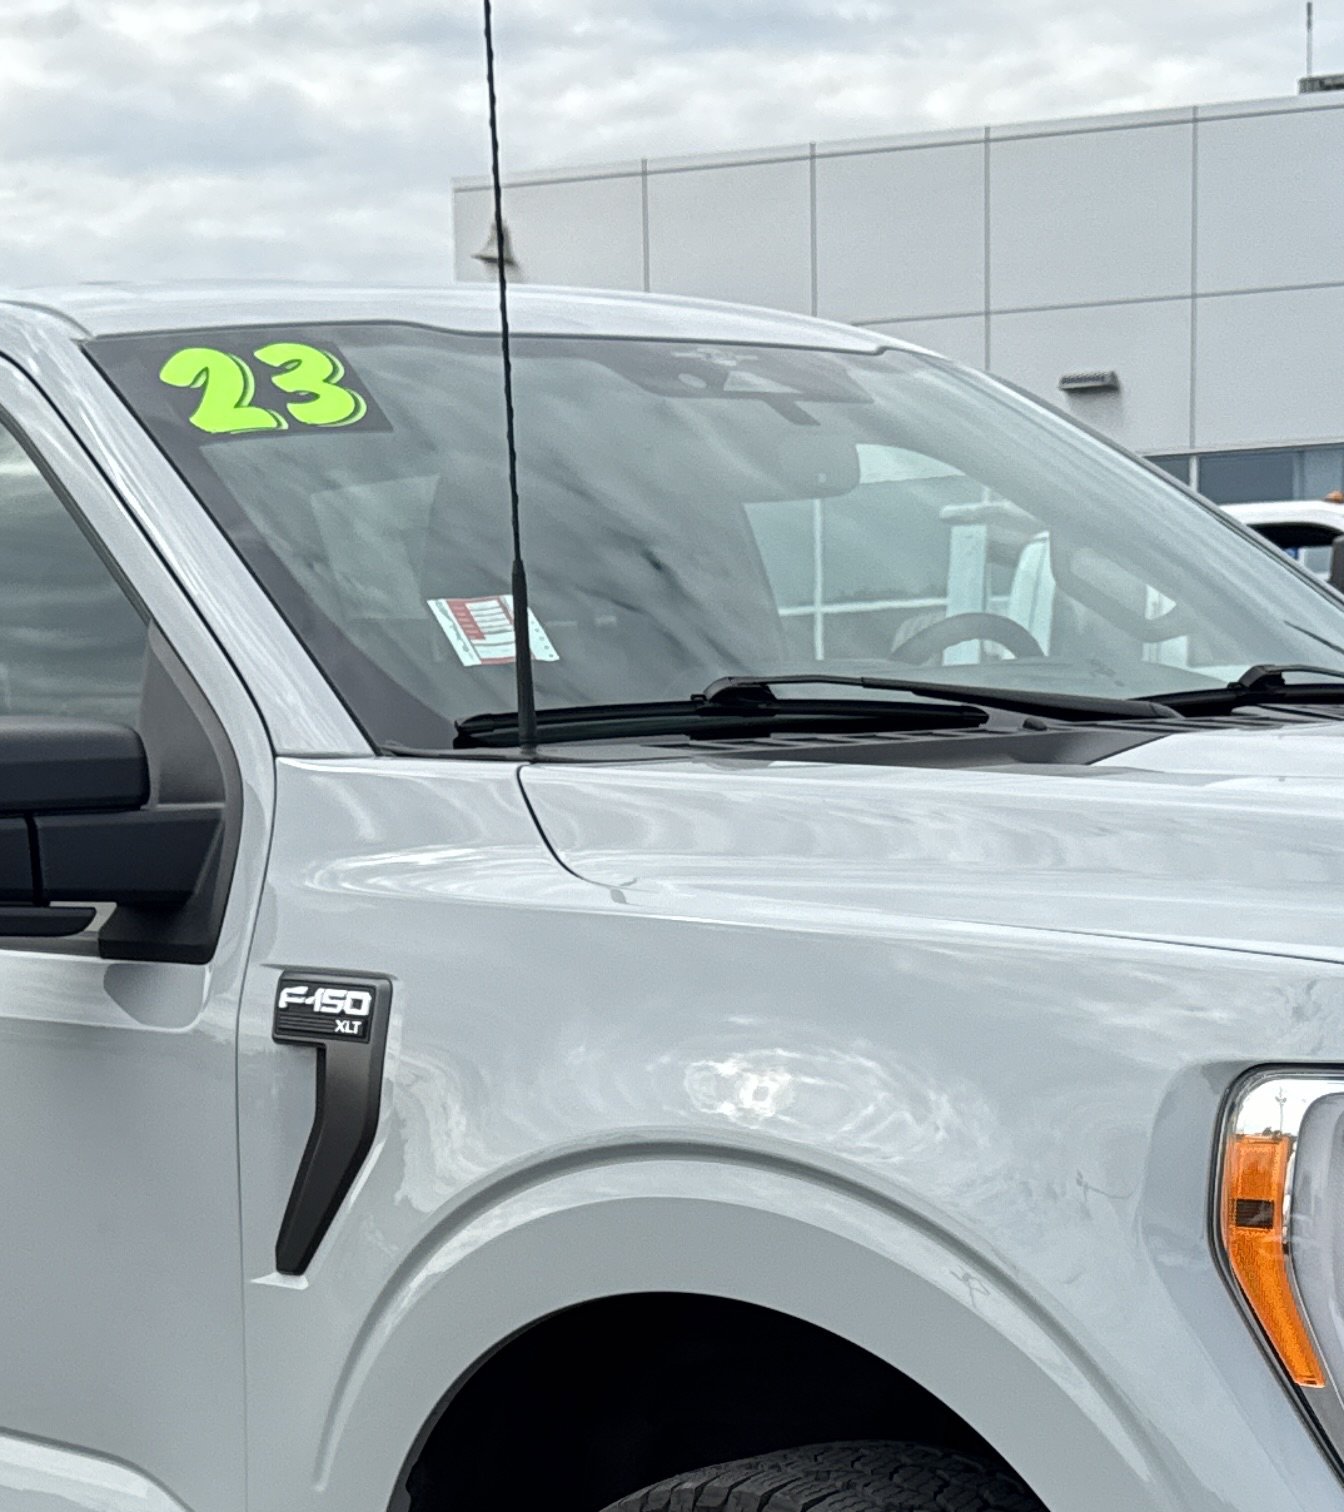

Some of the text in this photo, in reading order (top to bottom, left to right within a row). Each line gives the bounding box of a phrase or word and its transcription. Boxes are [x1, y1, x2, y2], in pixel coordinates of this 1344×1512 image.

[159, 342, 368, 434] 23
[278, 986, 372, 1016] F-150
[334, 1019, 362, 1034] XLT
